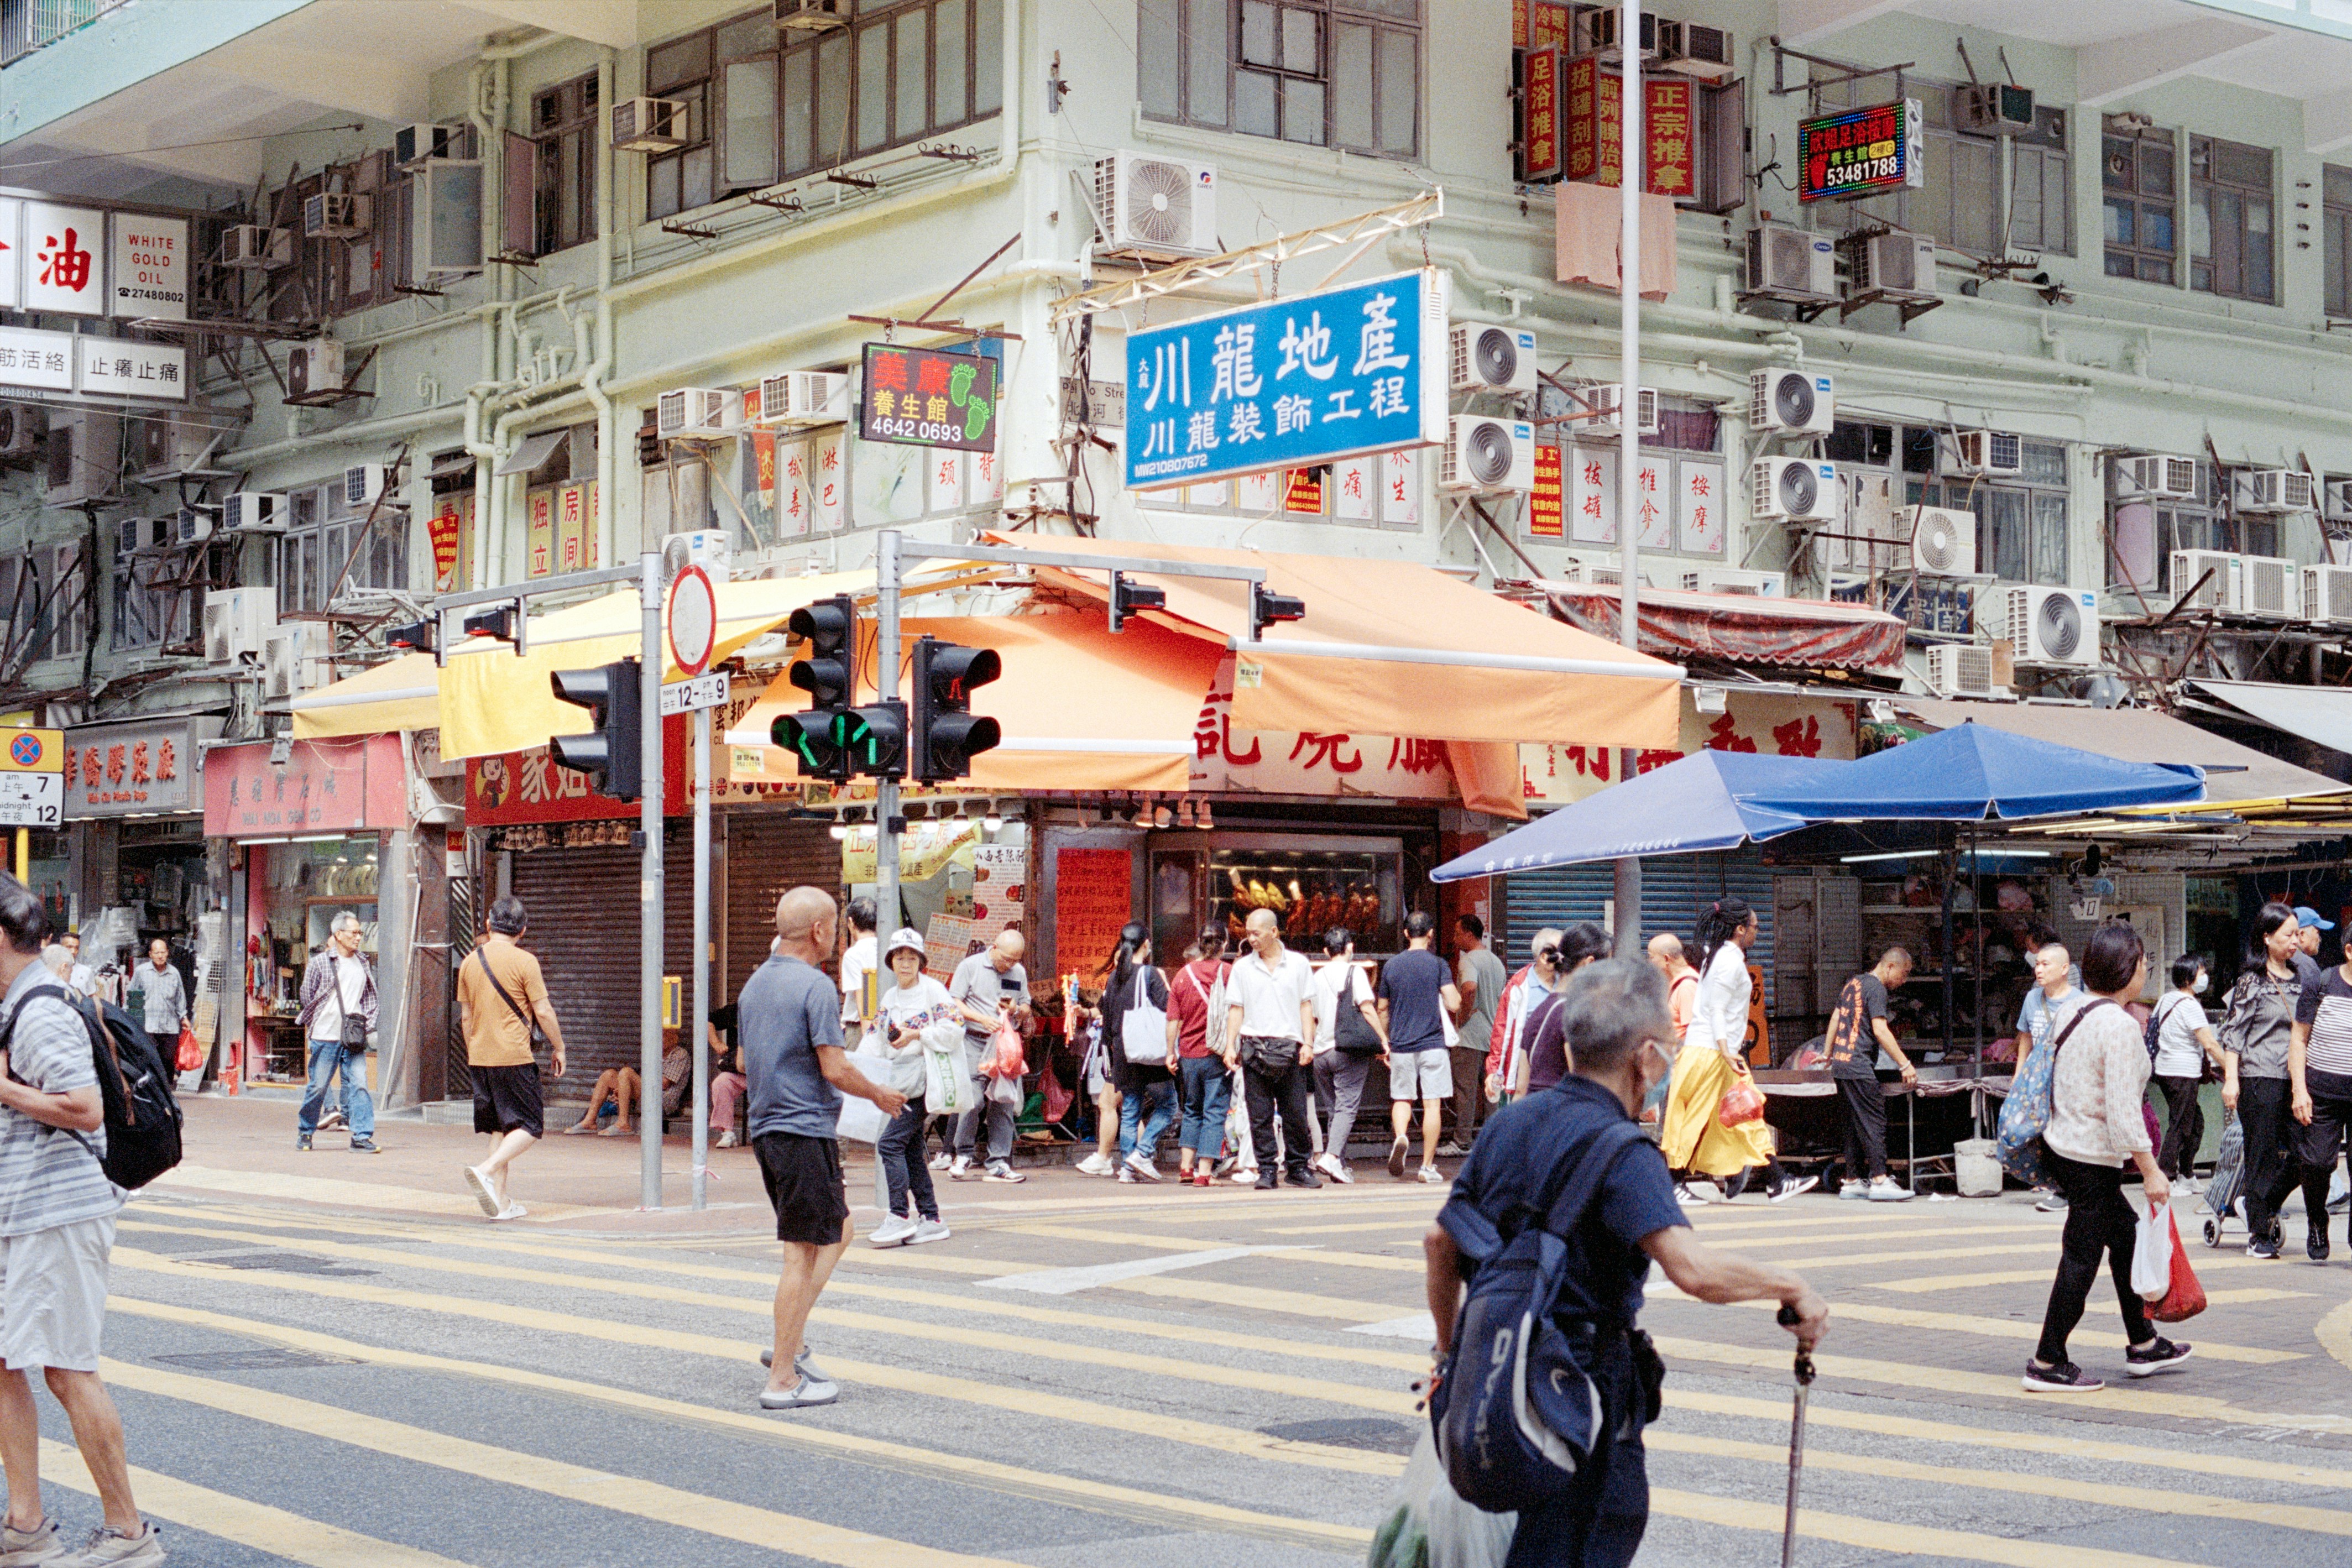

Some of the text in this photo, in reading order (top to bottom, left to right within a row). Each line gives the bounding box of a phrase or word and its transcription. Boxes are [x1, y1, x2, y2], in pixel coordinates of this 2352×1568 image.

[1531, 55, 1552, 165] 足浴推拿
[1653, 86, 1687, 189] 正宗推拿
[1831, 146, 1868, 166] 養生館
[1827, 156, 1897, 186] 53481788
[129, 234, 174, 249] WHITE
[37, 227, 91, 292] 油
[132, 253, 170, 267] GOLD
[139, 271, 163, 284] OIL
[132, 288, 184, 302] 27480802
[1144, 293, 1409, 411] 川龍地產
[875, 351, 952, 395] 美康
[1105, 386, 1125, 399] Stre
[874, 389, 948, 423] 養生館
[1142, 376, 1411, 457] 川龍裝飾工程
[872, 417, 961, 442] 4642 0693
[1535, 448, 1556, 461] 招工
[823, 447, 839, 506] 淋巴
[1583, 461, 1602, 524] 拔罐
[1639, 467, 1659, 529] 推拿
[1691, 474, 1710, 534] 按摩
[533, 496, 548, 574] 独立
[565, 489, 578, 568] 房间
[678, 686, 692, 707] 12
[701, 692, 713, 700] 下午
[703, 681, 712, 689] pm
[717, 679, 724, 699] 9
[663, 700, 676, 709] 中午
[2, 783, 23, 792] 上午
[37, 776, 49, 792] 7
[36, 806, 56, 822] 12
